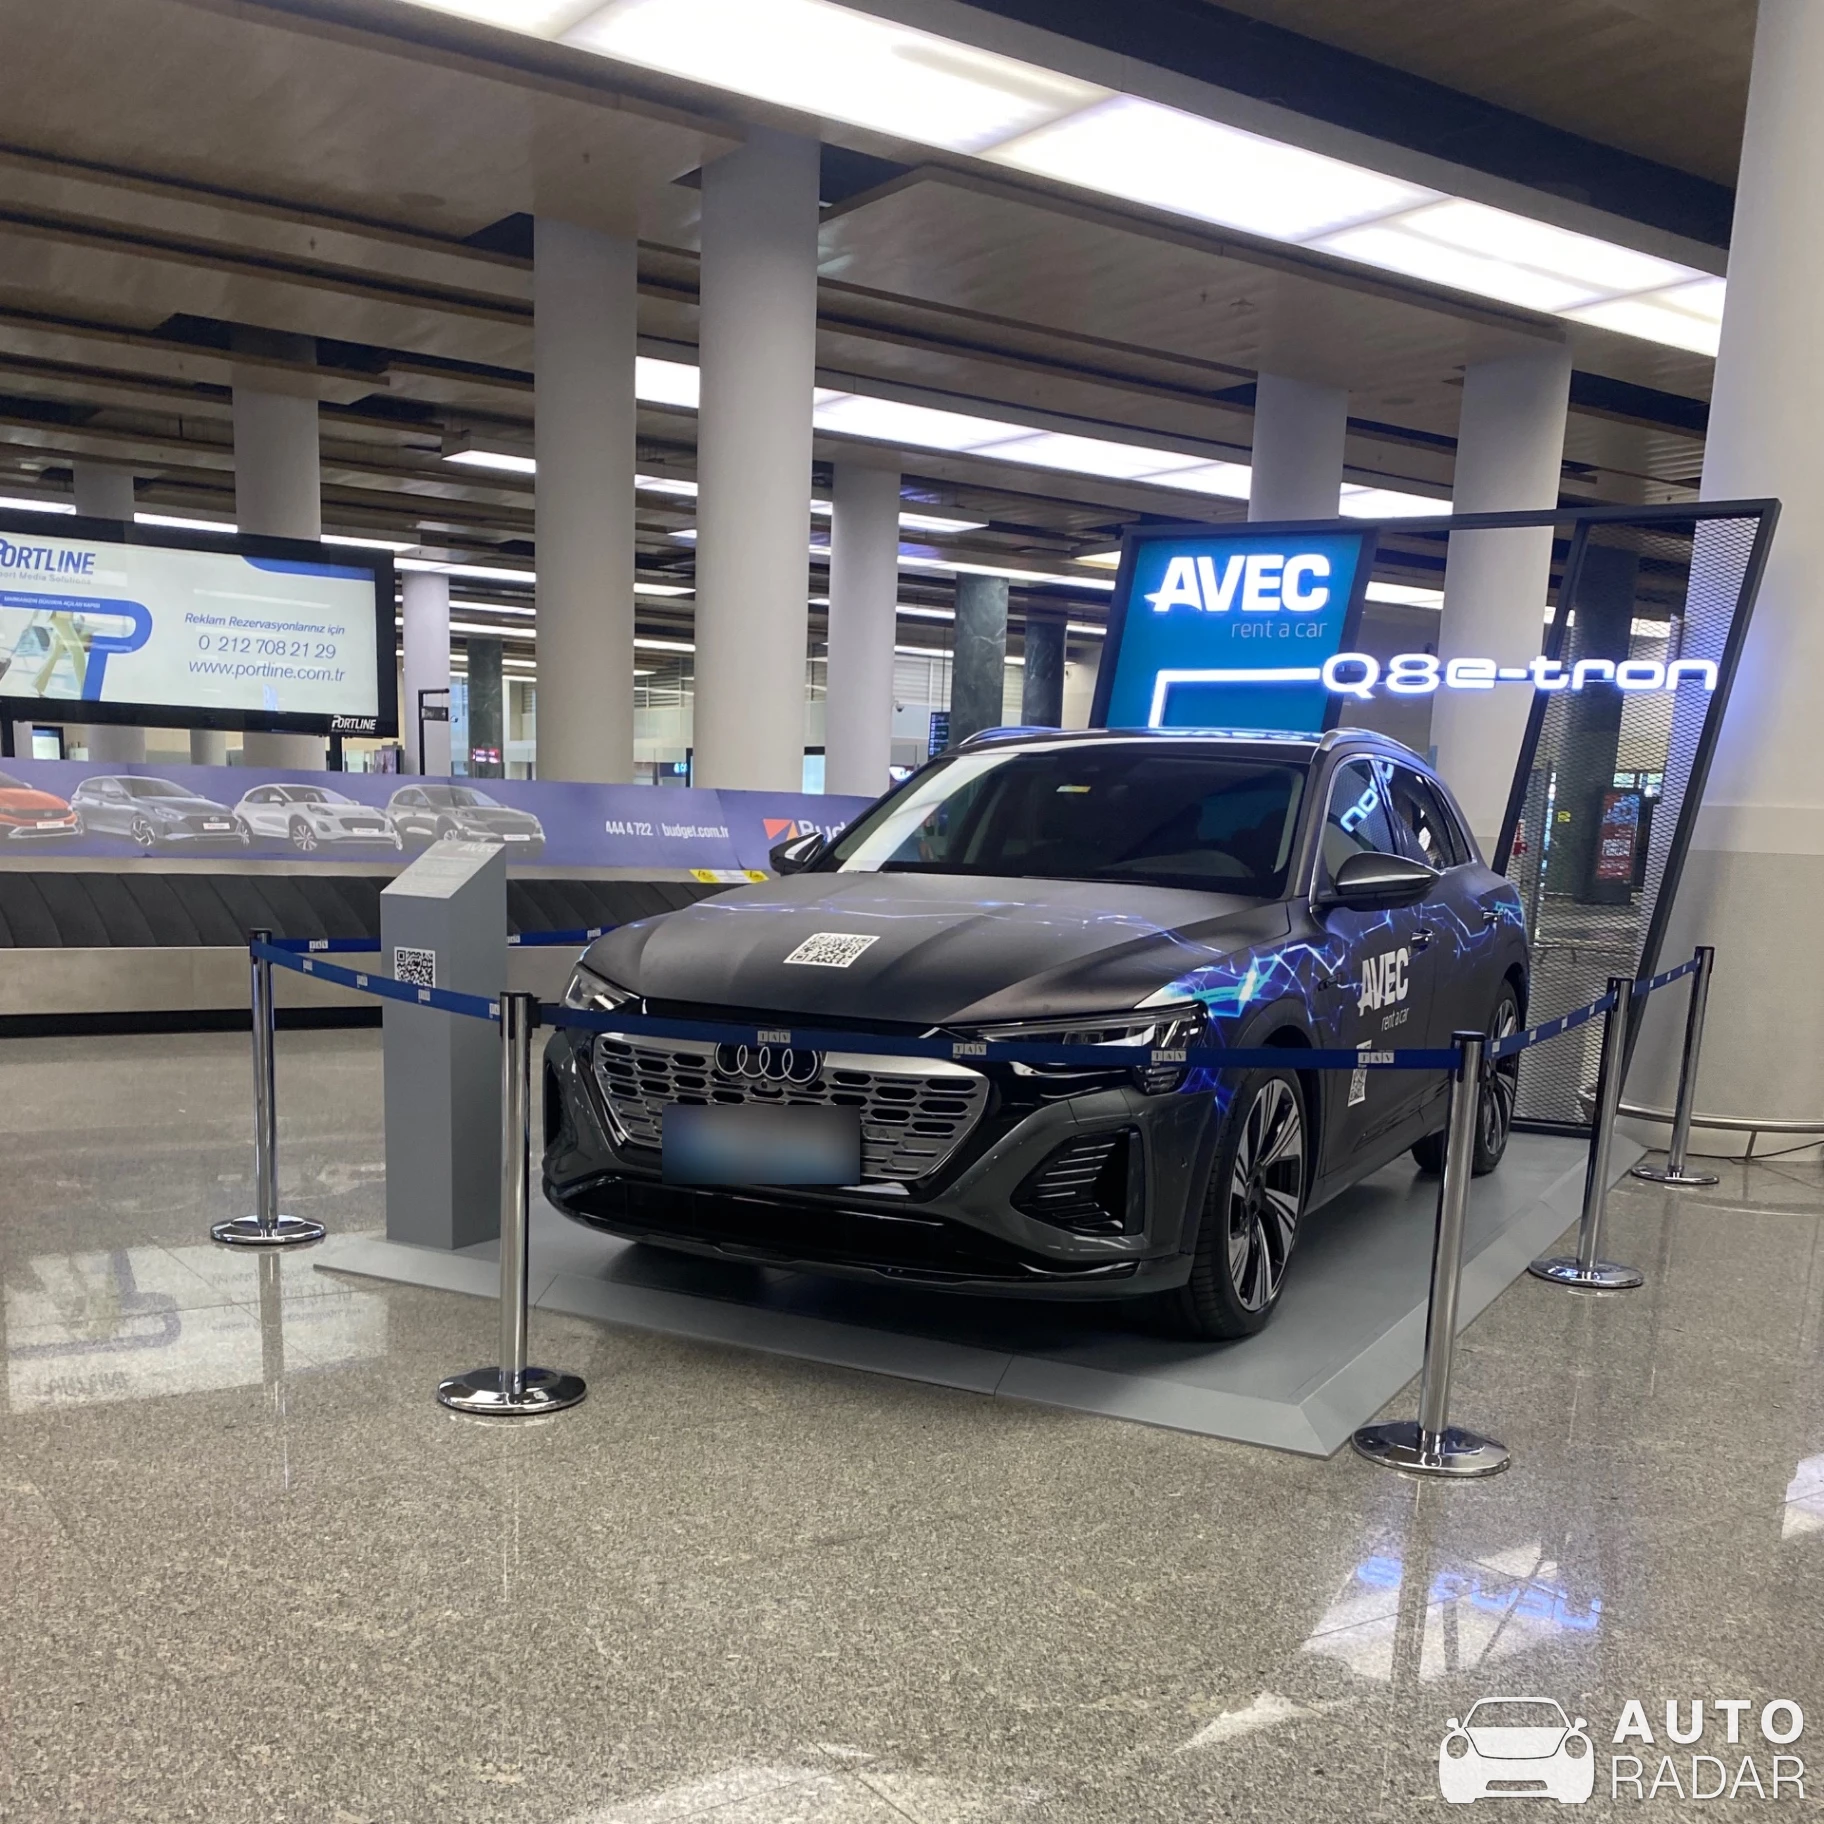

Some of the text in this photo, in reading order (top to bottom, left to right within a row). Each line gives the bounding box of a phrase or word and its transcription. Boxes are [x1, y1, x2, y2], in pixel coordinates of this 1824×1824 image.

[19, 571, 46, 582] Media
[1143, 553, 1330, 613] AVEC
[185, 612, 226, 626] Reklam
[327, 624, 345, 636] için
[1231, 620, 1328, 639] rent a car
[198, 635, 336, 659] 0 212 708 21 29
[189, 660, 346, 682] www.portline.com.tr
[331, 715, 377, 730] PORTLINE
[605, 820, 625, 835] 444
[661, 822, 729, 839] budget.com.tr
[798, 819, 847, 843] Bud
[1357, 947, 1409, 1017] AVEC
[1381, 1010, 1396, 1032] rent
[1399, 1007, 1410, 1023] car
[954, 1044, 986, 1054] TAV
[1152, 1051, 1185, 1061] TAV
[1360, 1053, 1393, 1062] TAV
